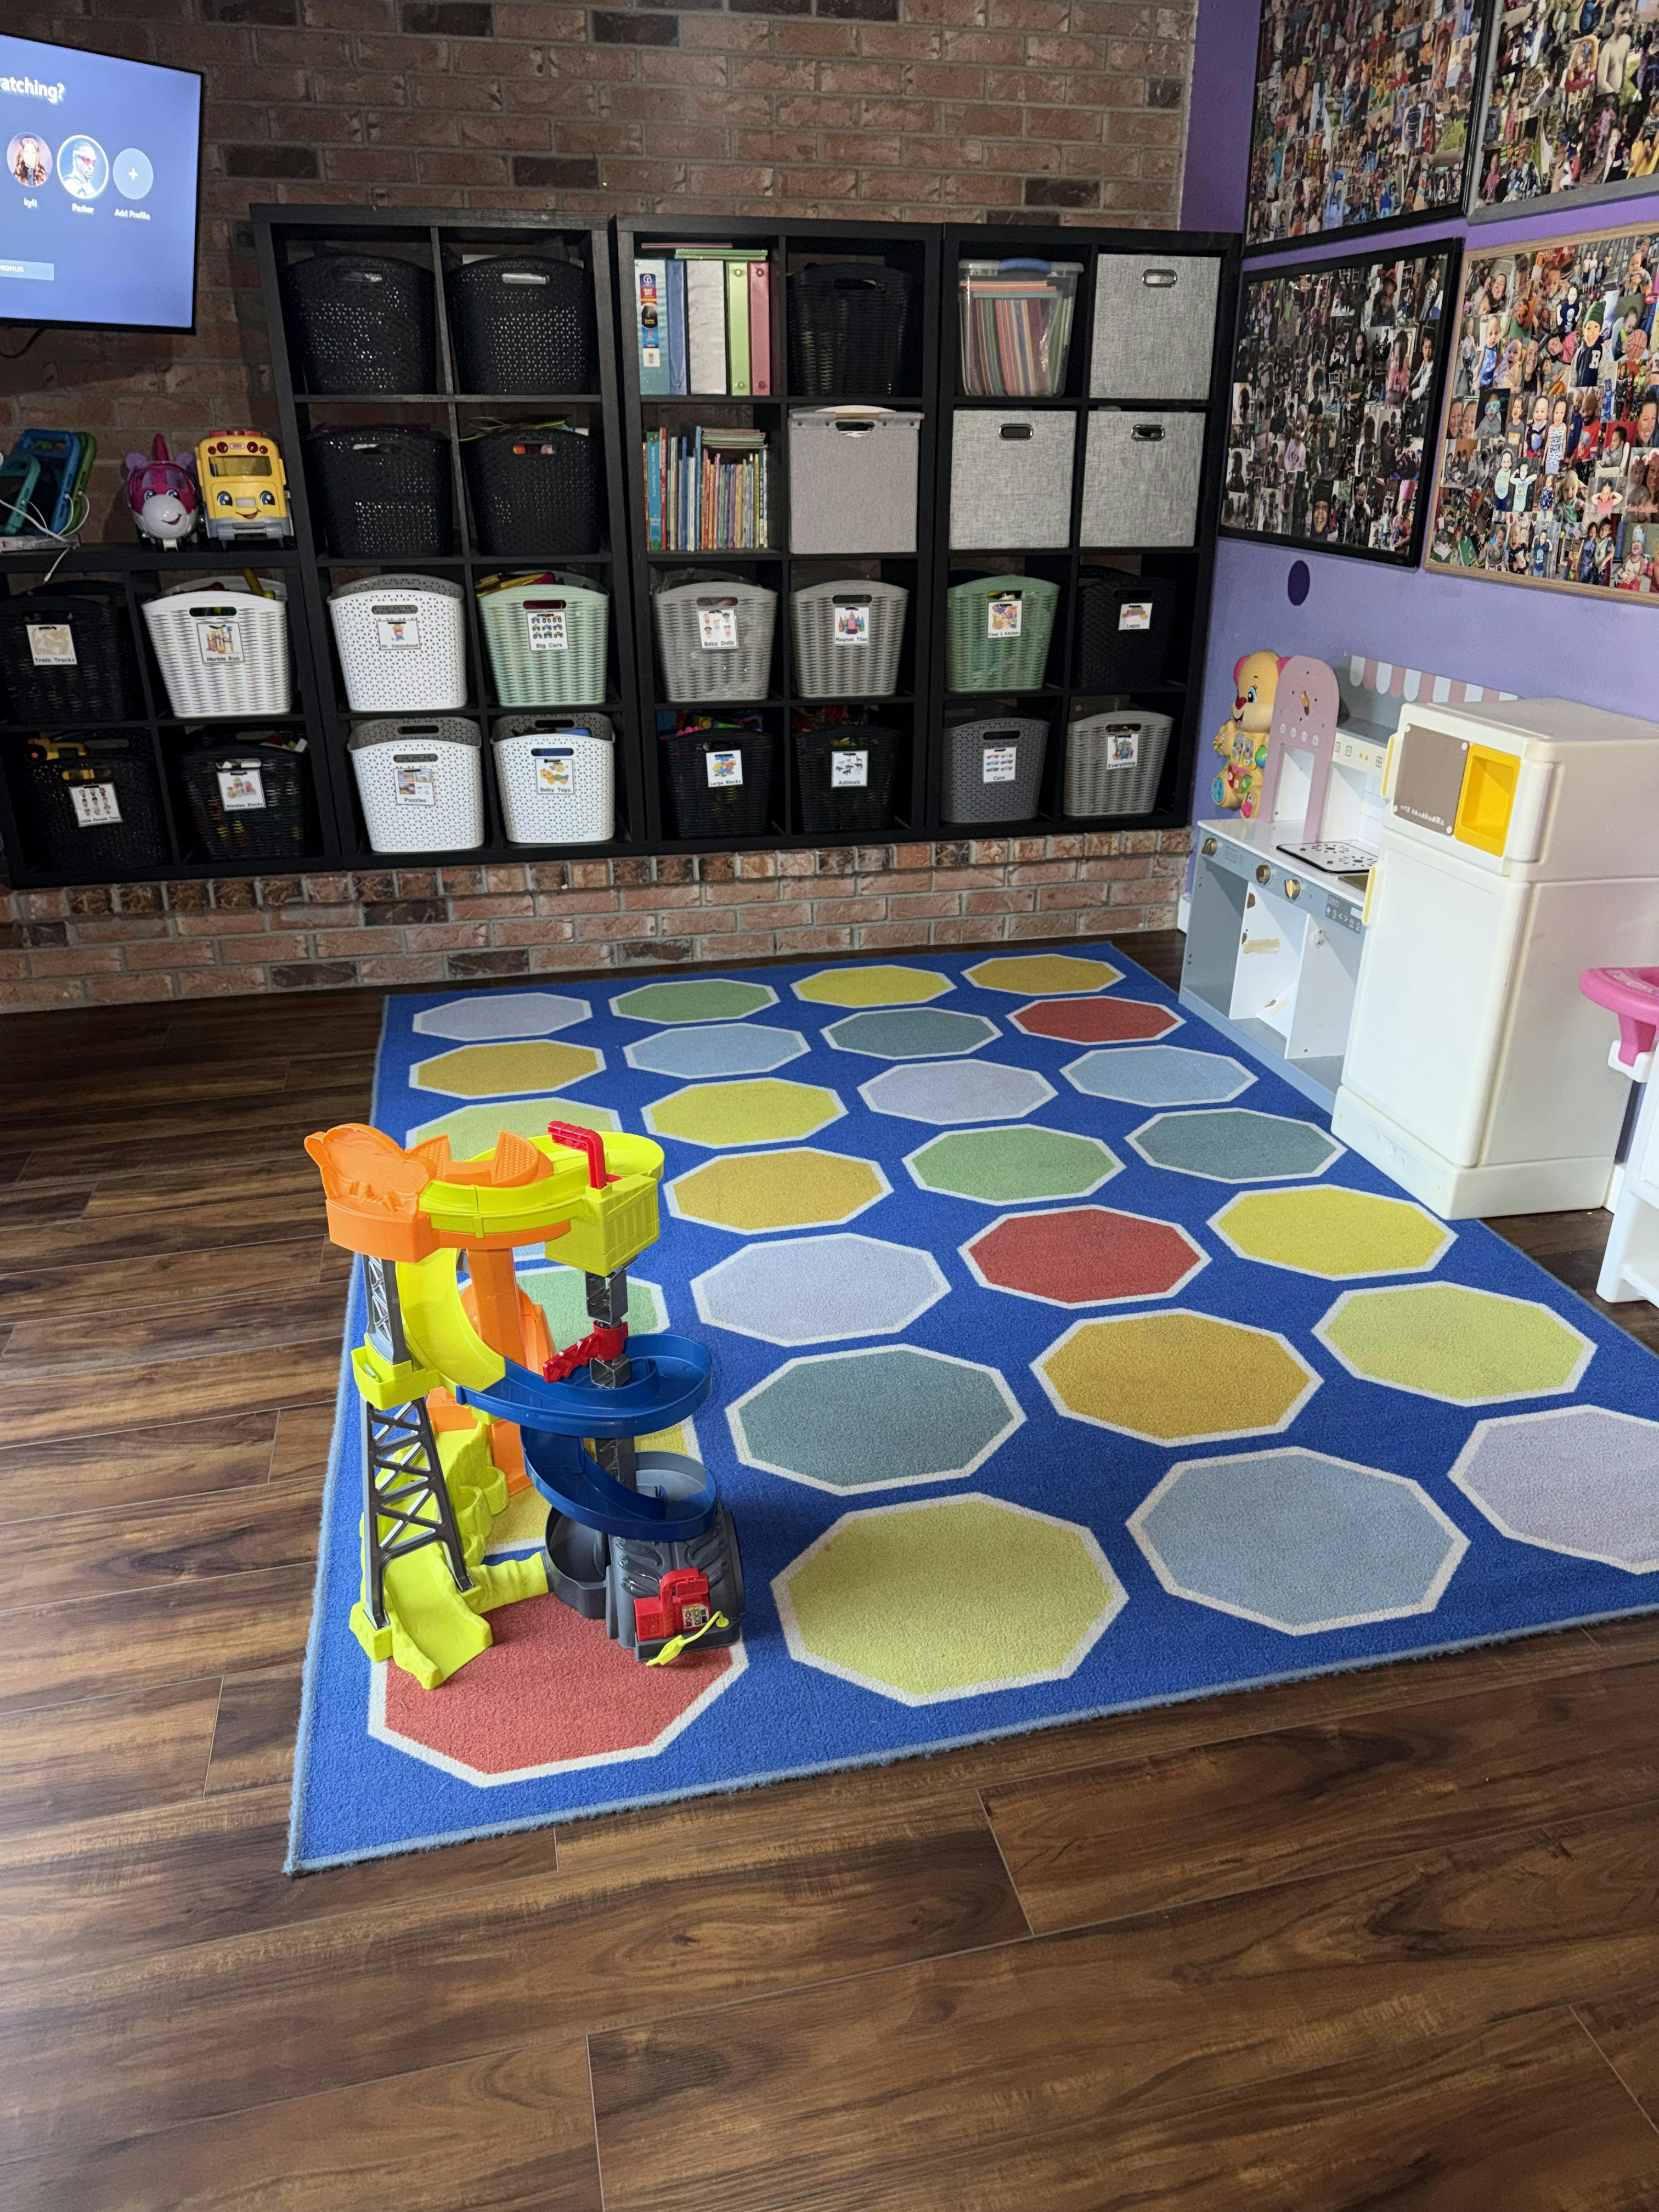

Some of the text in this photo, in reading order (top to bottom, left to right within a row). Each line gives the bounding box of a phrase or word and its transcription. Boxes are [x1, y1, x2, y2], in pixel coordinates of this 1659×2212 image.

[0, 76, 65, 103] atching?
[72, 203, 94, 214] Parker
[114, 208, 150, 219] Add Profile
